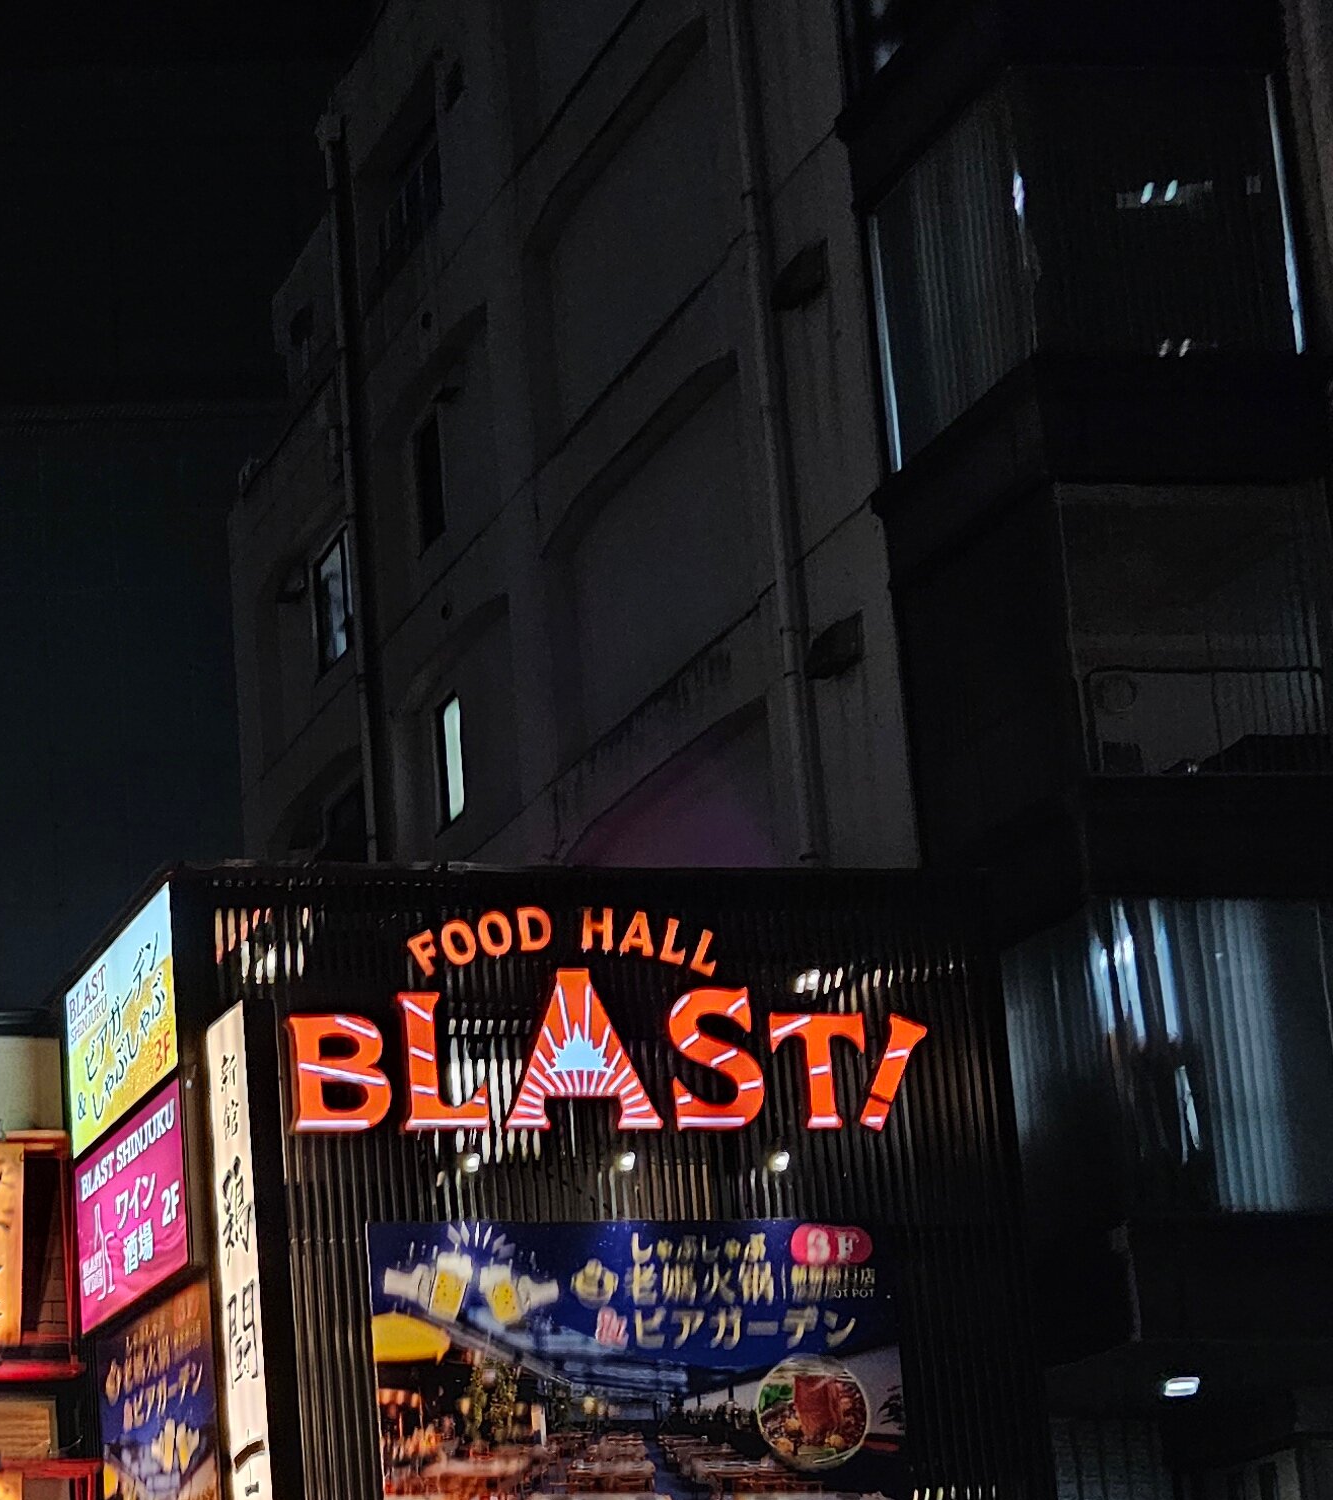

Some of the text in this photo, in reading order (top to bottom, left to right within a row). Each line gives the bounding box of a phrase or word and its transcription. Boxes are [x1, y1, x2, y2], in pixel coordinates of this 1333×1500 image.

[406, 907, 719, 977] FOOD HALL
[68, 963, 108, 1024] BLAST
[70, 993, 108, 1044] SHINJUKU
[85, 930, 160, 1083] ビアガーデン
[91, 970, 167, 1121] しゃぶしゃぶ
[152, 1032, 172, 1075] 3F
[80, 1099, 175, 1202] BLAST SHINJUKU
[114, 1172, 158, 1231] ワイン
[161, 1180, 180, 1228] 2F
[122, 1219, 155, 1276] 酒場
[635, 1305, 856, 1349] ビアガーデン
